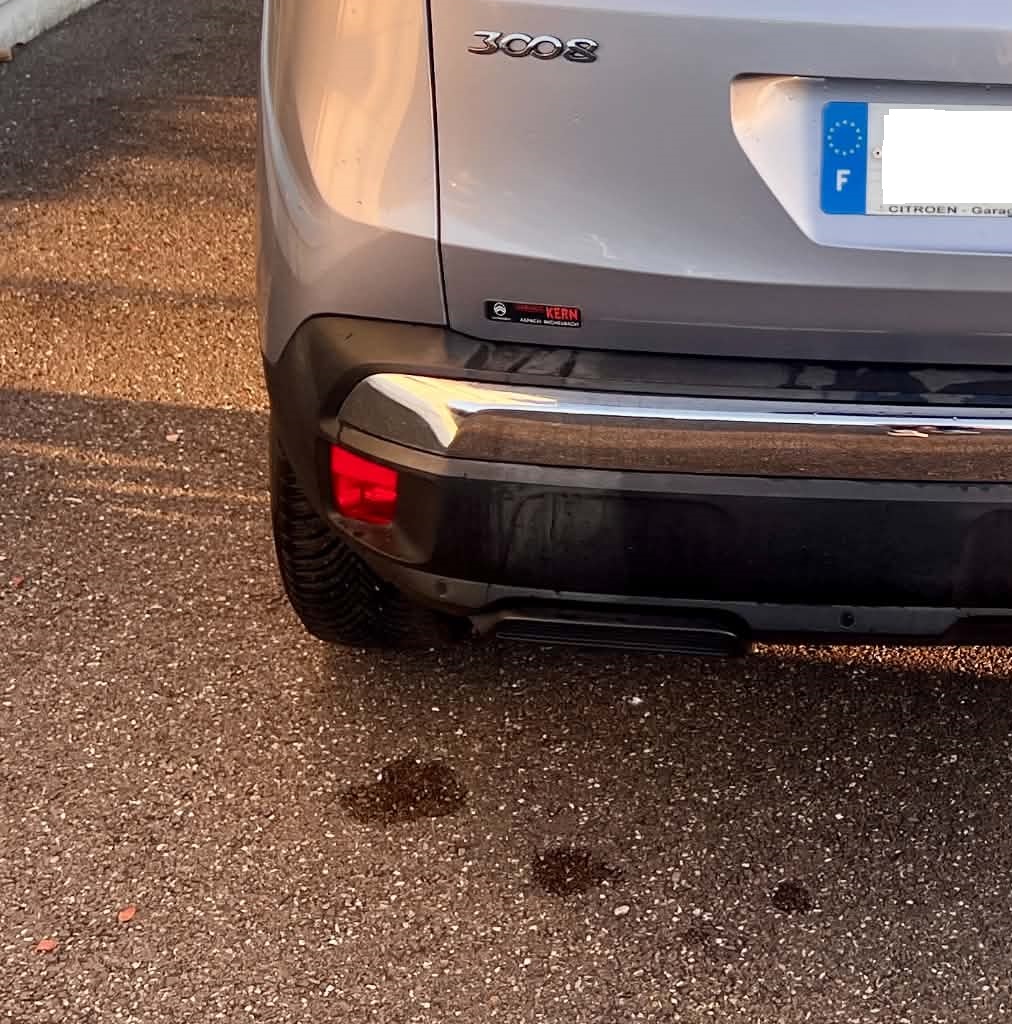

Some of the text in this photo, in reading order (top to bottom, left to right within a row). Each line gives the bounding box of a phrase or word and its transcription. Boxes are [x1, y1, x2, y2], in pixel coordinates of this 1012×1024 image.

[467, 30, 600, 63] 3008
[836, 169, 851, 192] F
[888, 205, 958, 215] CITROEN
[546, 306, 578, 320] KERN
